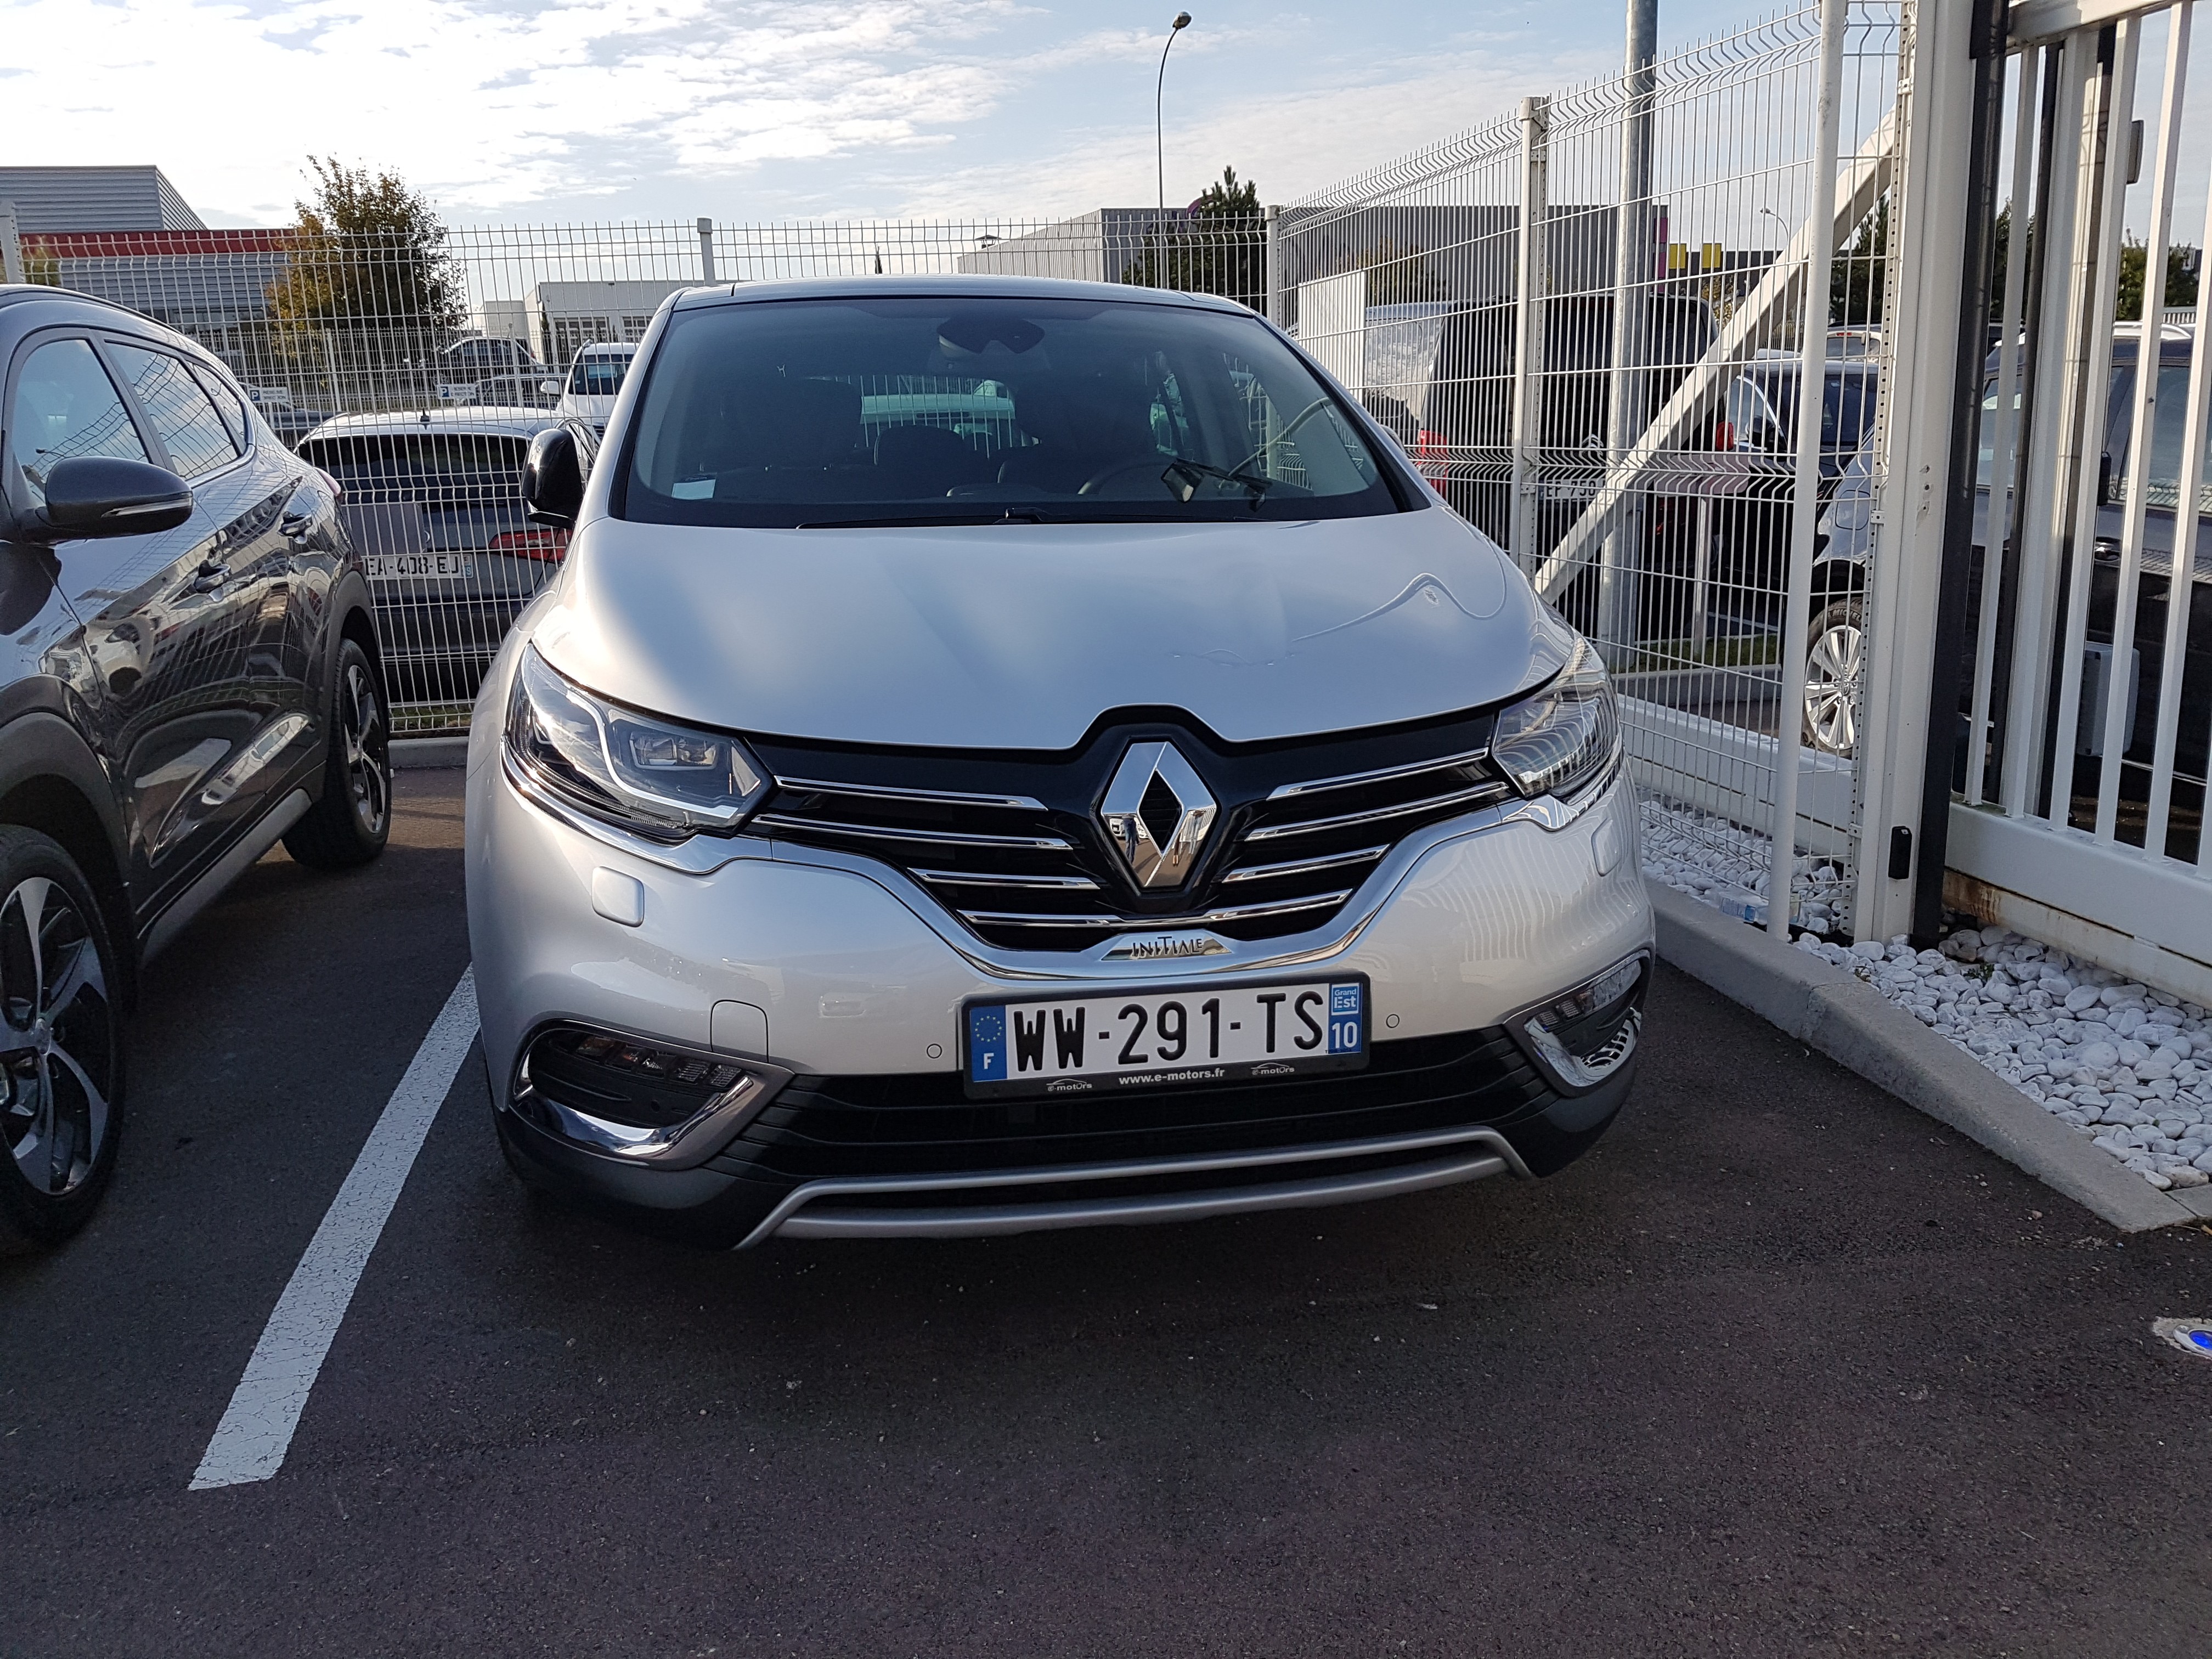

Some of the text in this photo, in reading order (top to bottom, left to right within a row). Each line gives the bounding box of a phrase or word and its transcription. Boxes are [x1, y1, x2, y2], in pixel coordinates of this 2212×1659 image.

[1132, 936, 1203, 957] INITIALE
[1334, 996, 1357, 1008] Est
[1014, 991, 1323, 1071] WW-291-TS
[1332, 1022, 1358, 1048] 10
[984, 1053, 994, 1069] F
[1119, 1068, 1225, 1085] www.e-motors.fr
